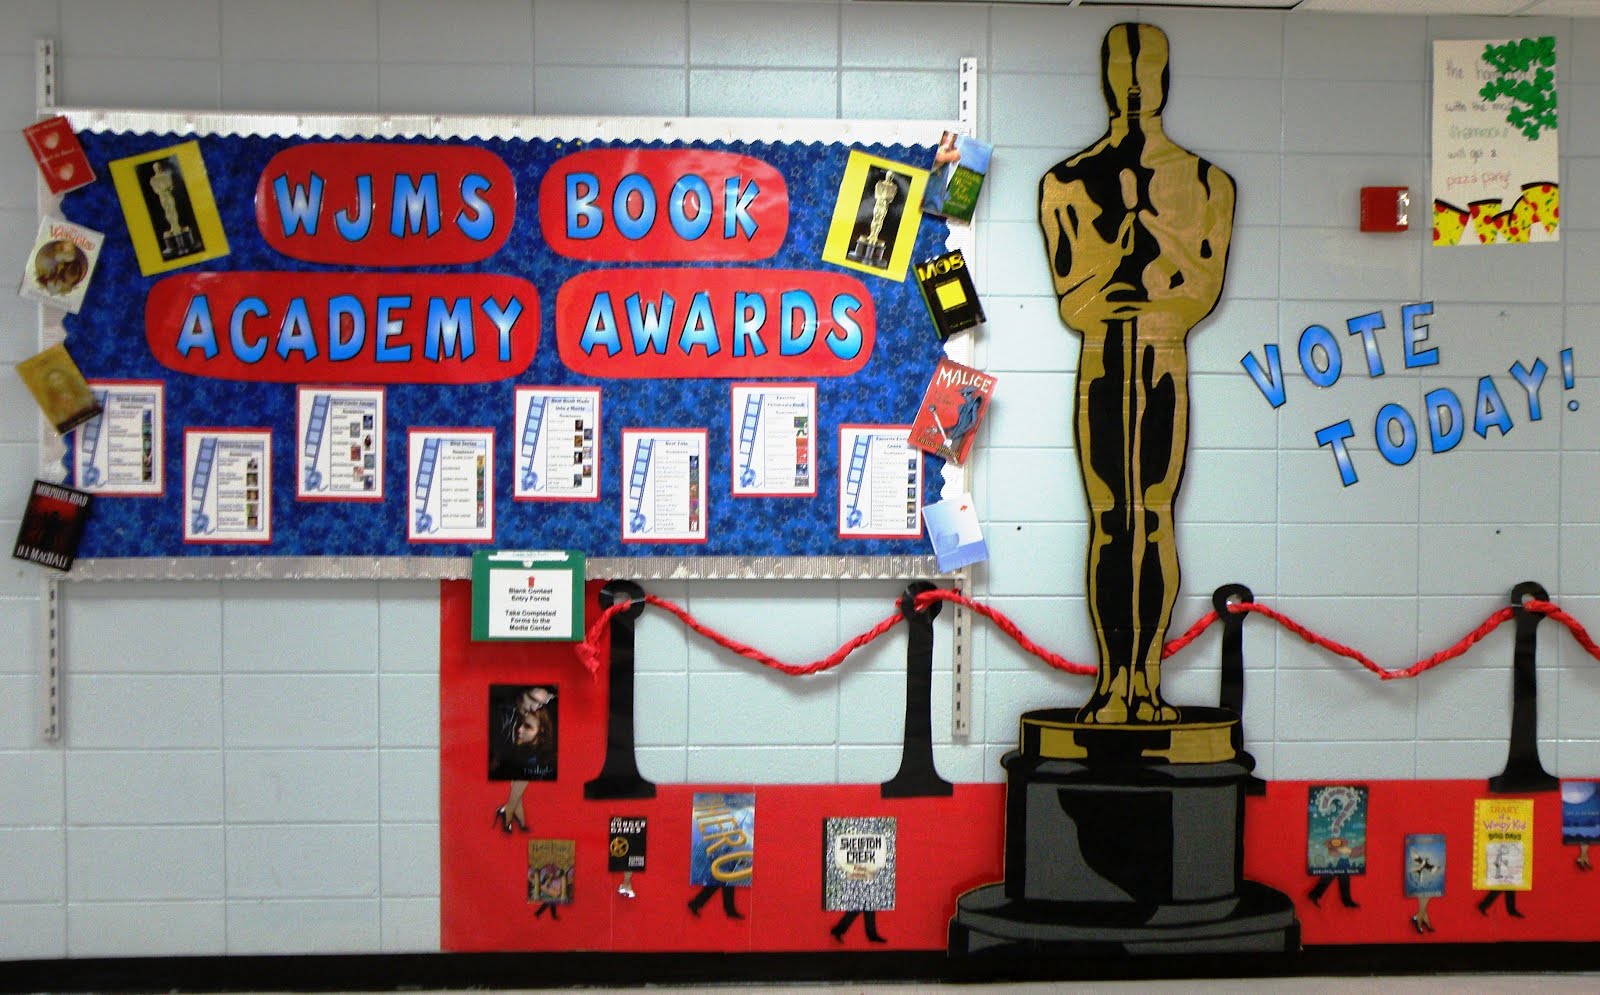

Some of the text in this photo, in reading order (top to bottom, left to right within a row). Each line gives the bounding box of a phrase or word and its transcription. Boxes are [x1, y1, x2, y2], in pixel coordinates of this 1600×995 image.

[272, 171, 761, 242] WJMS BOOK
[917, 252, 965, 281] MOB
[175, 289, 864, 364] ACADEMY AWARDS
[1239, 300, 1440, 410] VOTE
[936, 366, 993, 394] MALICE
[1314, 347, 1580, 488] TODAY!
[68, 493, 88, 508] ROAD
[511, 595, 528, 603] Entry
[521, 610, 557, 618] Completed
[1483, 819, 1527, 833] Wimpy Kid
[693, 803, 753, 882] HERO
[846, 850, 876, 864] CREEK
